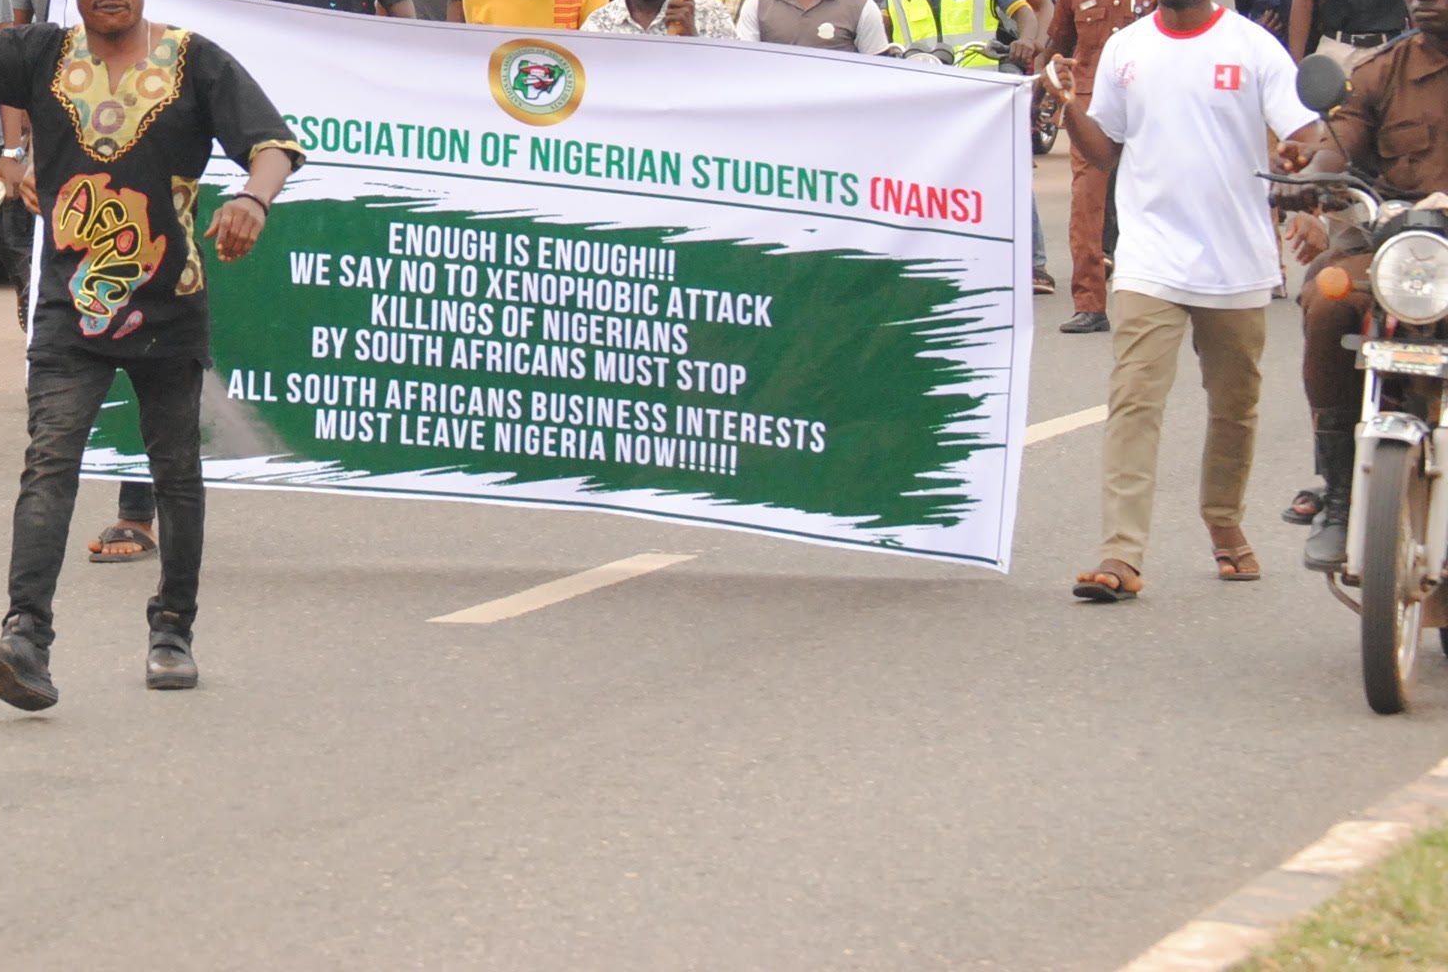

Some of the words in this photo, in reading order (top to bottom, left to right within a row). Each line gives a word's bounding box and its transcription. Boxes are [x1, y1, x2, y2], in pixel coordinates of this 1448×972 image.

[282, 115, 470, 164] SOCIATION
[481, 132, 520, 168] OF
[531, 138, 682, 186] NIGERIAN
[692, 155, 859, 206] STUDENTS
[60, 179, 143, 318] AFRICA
[389, 222, 497, 265] ENOUGH
[505, 234, 531, 265] IS
[538, 236, 676, 281] ENOUGH!!!
[290, 252, 330, 286] WE
[339, 255, 392, 290] SAY
[399, 261, 438, 295] NO
[446, 265, 480, 298] TO
[487, 269, 659, 317] XENOPHOBIC
[666, 289, 773, 328] ATTACK
[371, 293, 495, 336] KILLINGS
[505, 306, 535, 339] OF
[542, 309, 688, 356] NIGERIANS
[312, 327, 349, 360] BY
[355, 328, 443, 368] SOUTH
[451, 337, 586, 381] AFRICANS
[594, 349, 669, 389] MUST
[676, 358, 747, 396] STOP
[228, 368, 277, 402] ALL
[286, 372, 376, 410] SOUTH
[385, 377, 522, 421] AFRICANS
[531, 390, 668, 435] BUSINESS
[676, 405, 827, 453] INTERESTS
[315, 408, 391, 444] MUST
[400, 416, 485, 452] LEAVE
[494, 422, 607, 462] NIGERIA
[615, 432, 737, 476] NOW!!!!!!
